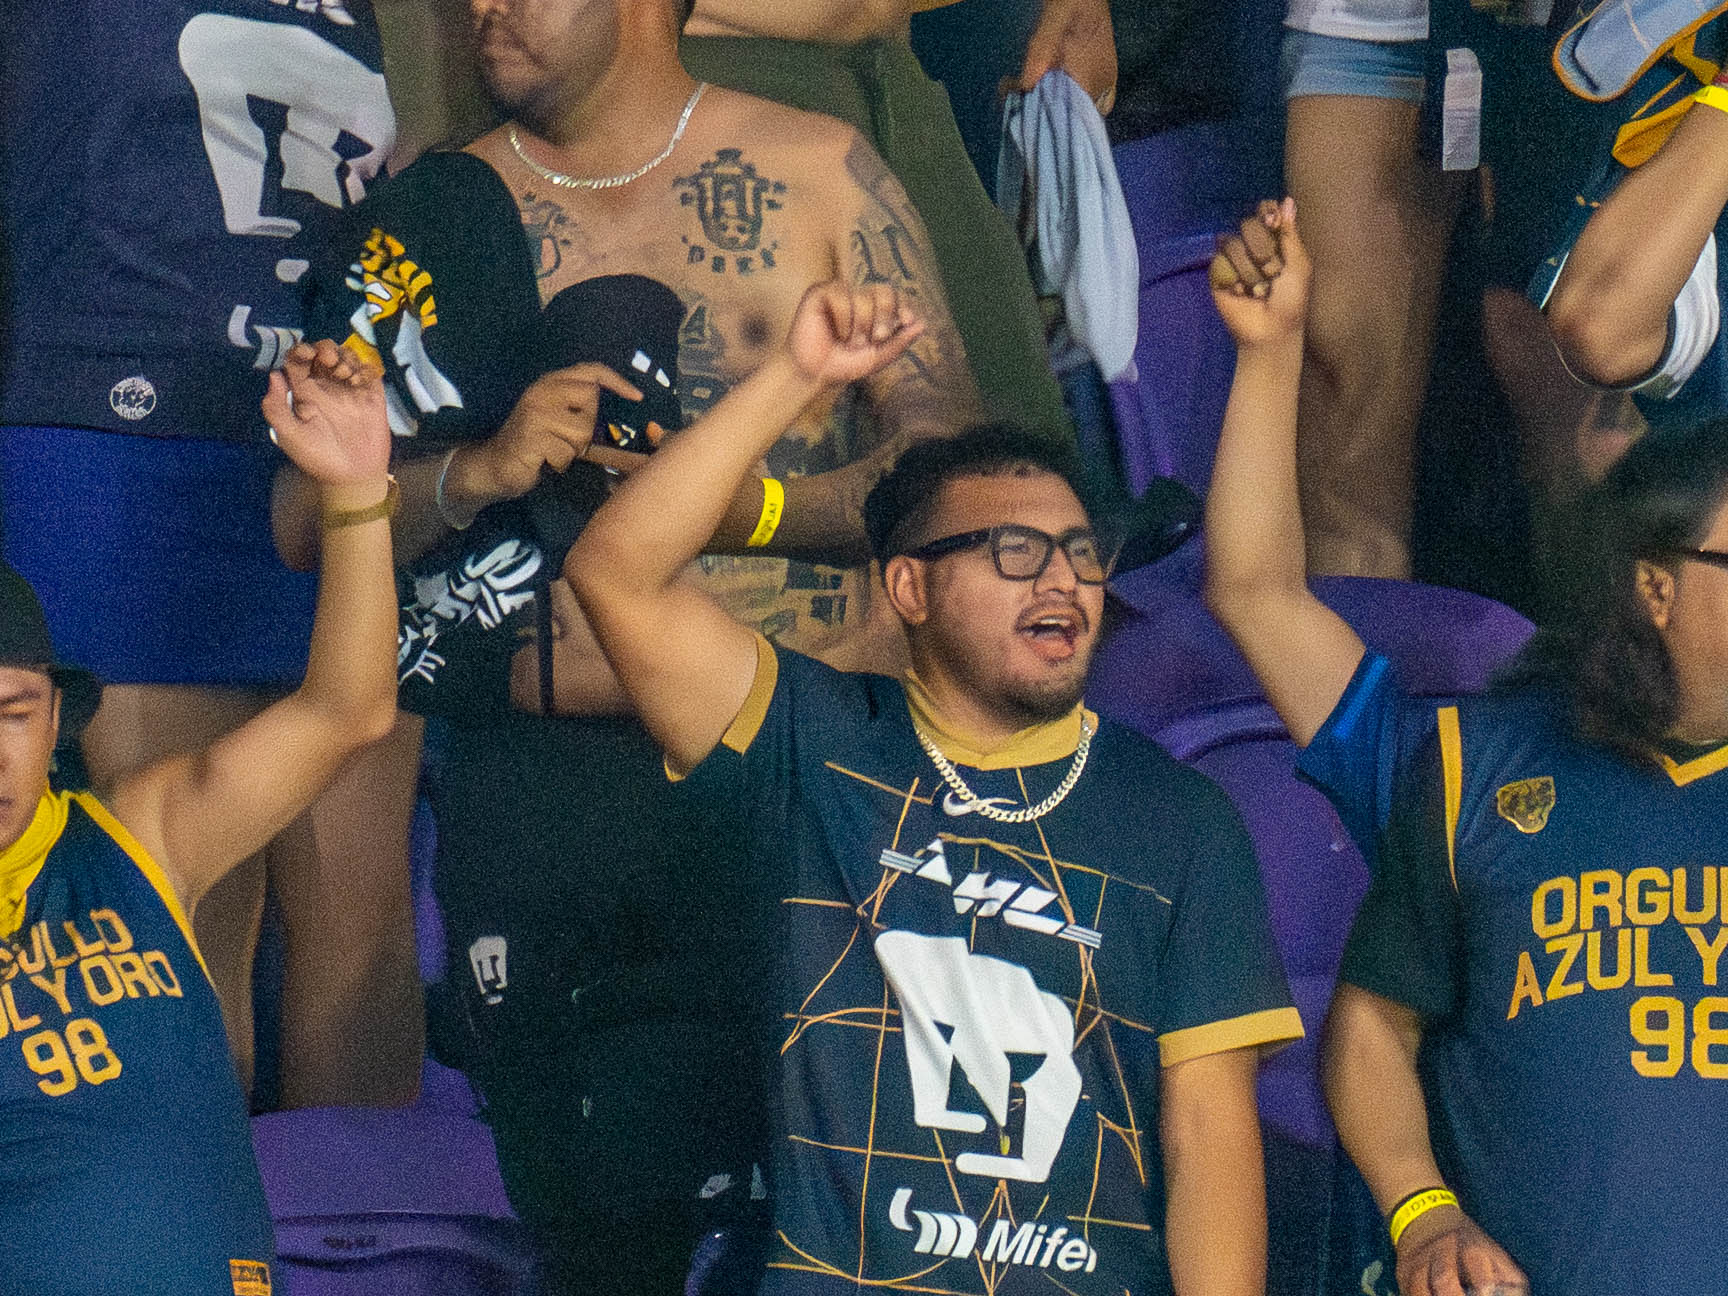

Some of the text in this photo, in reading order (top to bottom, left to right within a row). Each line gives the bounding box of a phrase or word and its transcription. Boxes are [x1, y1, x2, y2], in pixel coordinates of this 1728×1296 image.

[35, 972, 74, 1015] Y
[83, 949, 183, 1008] ORO
[1507, 926, 1674, 1021] AZUL
[22, 1017, 123, 1097] 98
